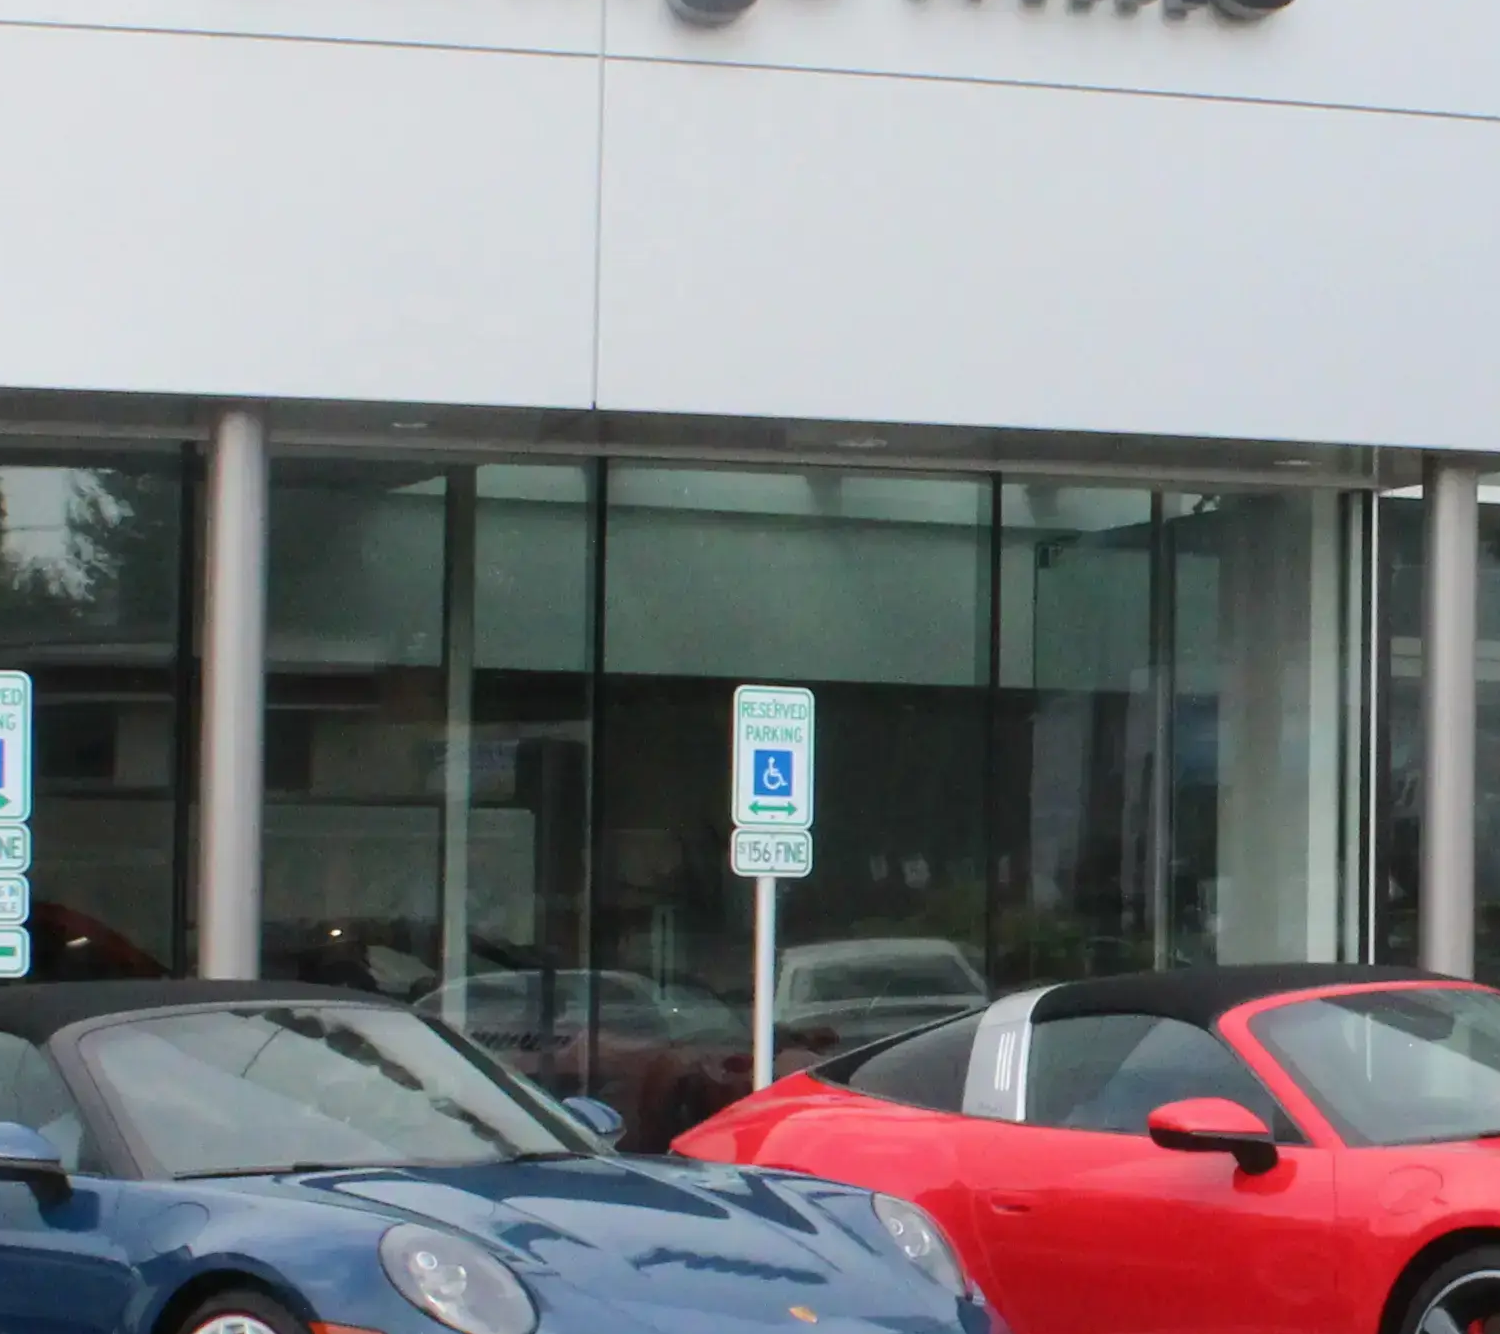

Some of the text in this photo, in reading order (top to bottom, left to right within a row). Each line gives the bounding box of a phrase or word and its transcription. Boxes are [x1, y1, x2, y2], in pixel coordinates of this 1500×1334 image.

[741, 700, 808, 720] RESERVED
[745, 725, 803, 744] PARKING
[774, 840, 807, 864] FINE
